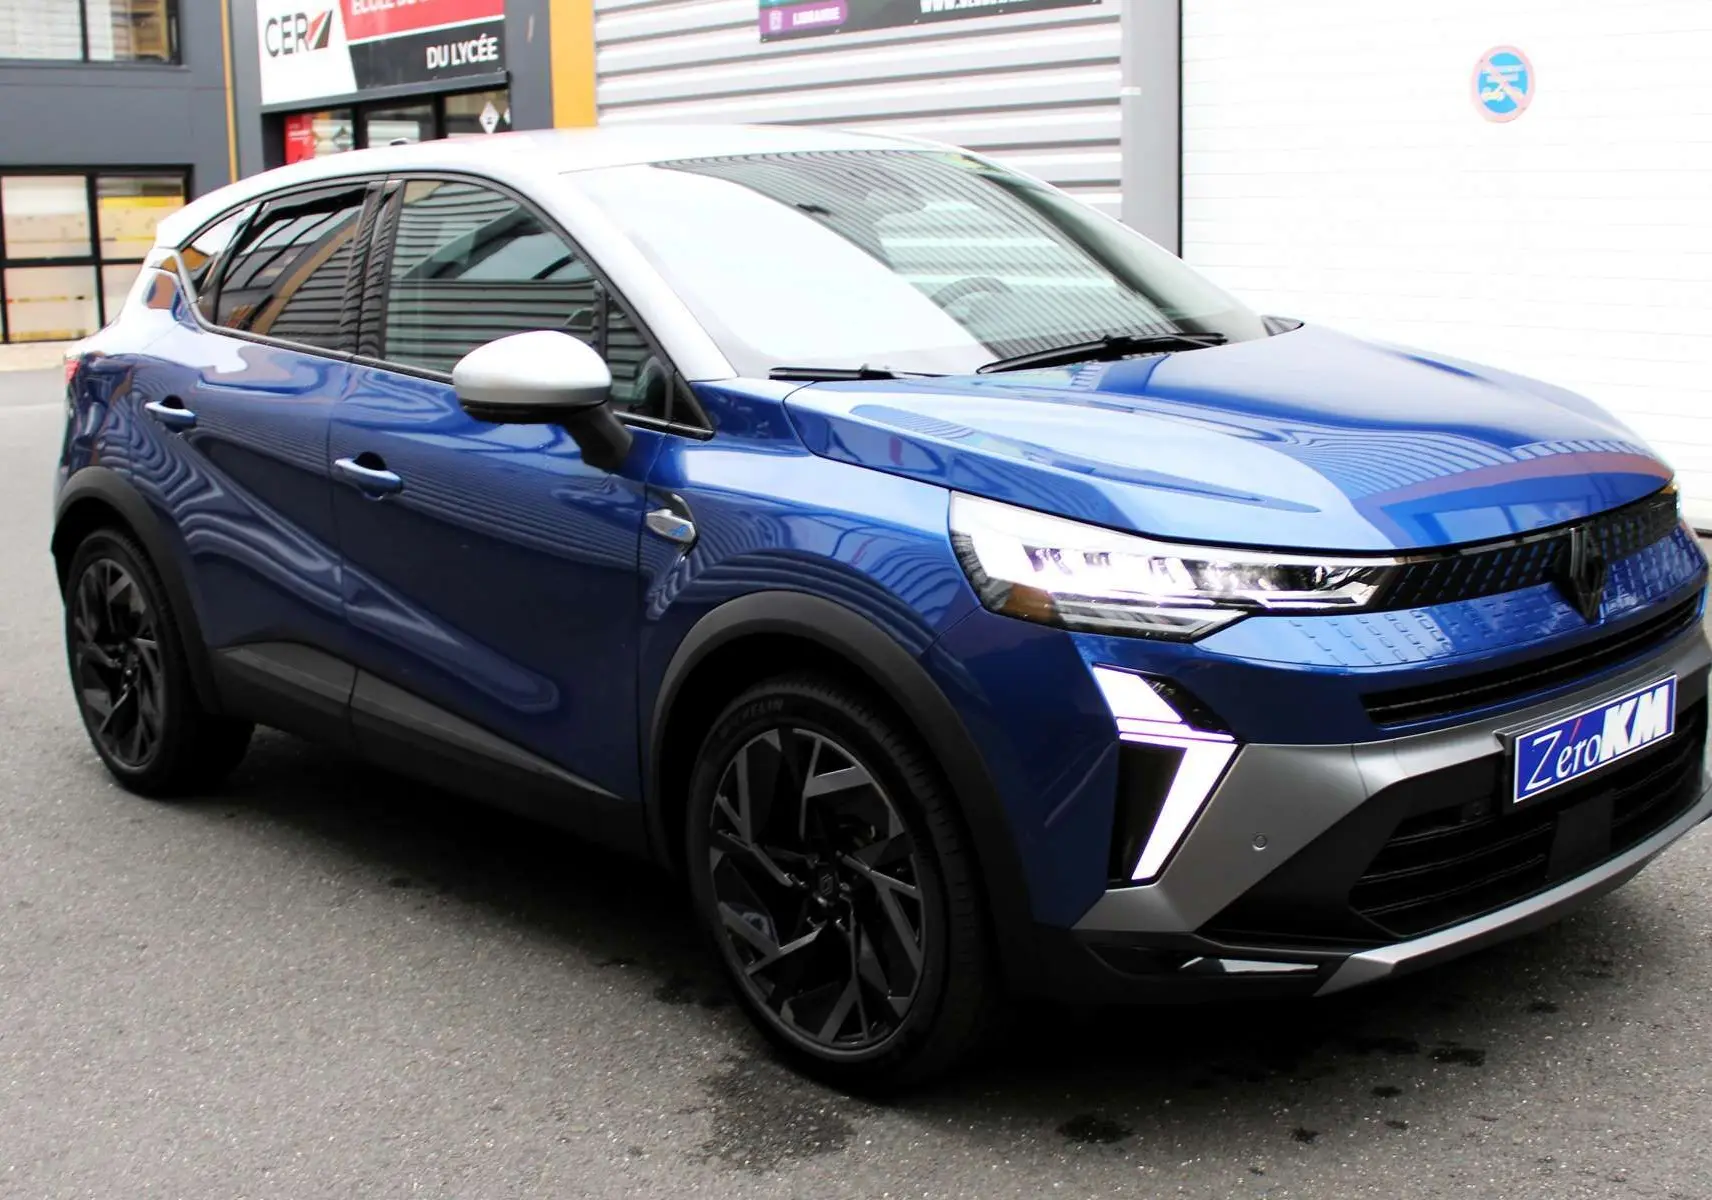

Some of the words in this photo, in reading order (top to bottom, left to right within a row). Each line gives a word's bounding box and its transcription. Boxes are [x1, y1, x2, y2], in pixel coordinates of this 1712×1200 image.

[265, 13, 310, 57] CER
[426, 44, 449, 70] DU
[451, 33, 499, 66] LYCÉE
